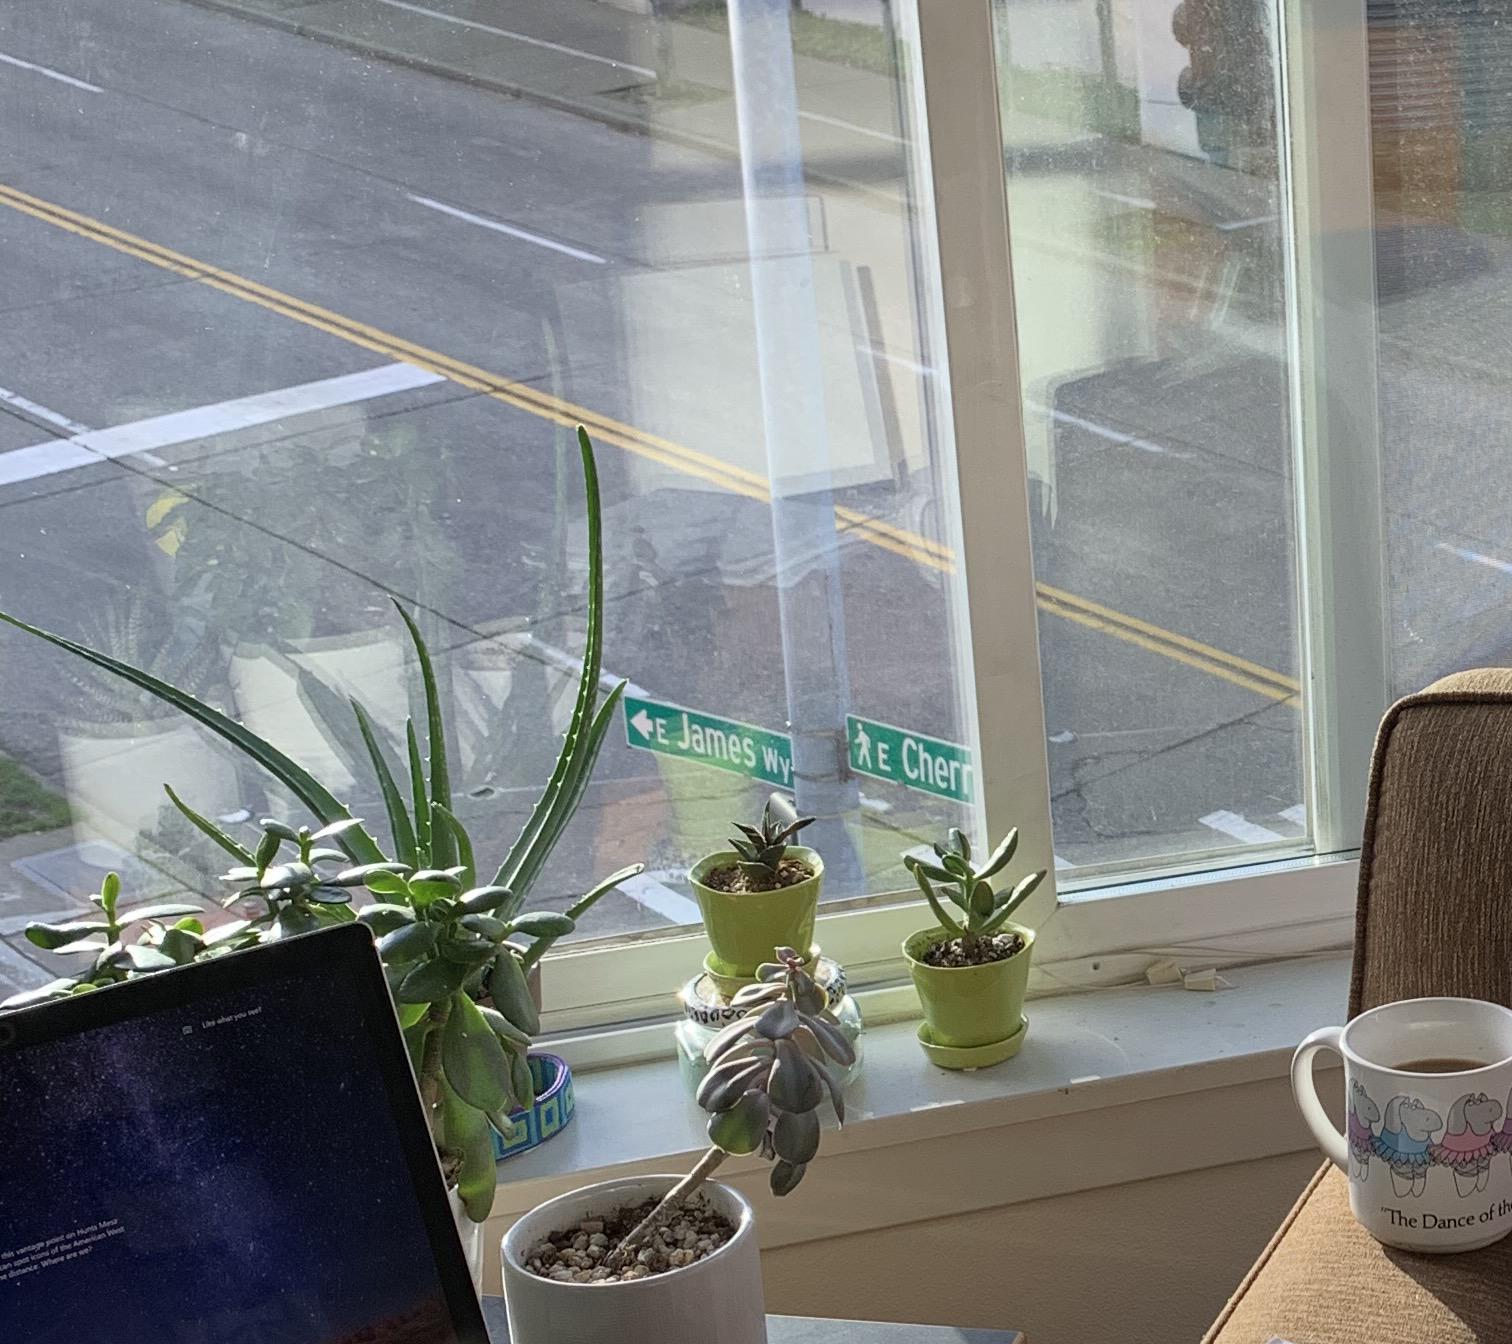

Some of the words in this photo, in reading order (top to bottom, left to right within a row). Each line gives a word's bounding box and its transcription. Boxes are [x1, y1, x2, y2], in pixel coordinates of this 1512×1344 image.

[655, 717, 670, 746] E
[677, 712, 757, 769] James
[877, 741, 892, 773] E
[901, 736, 974, 795] Cherr
[1422, 1213, 1475, 1230] Dance
[1479, 1202, 1496, 1224] of
